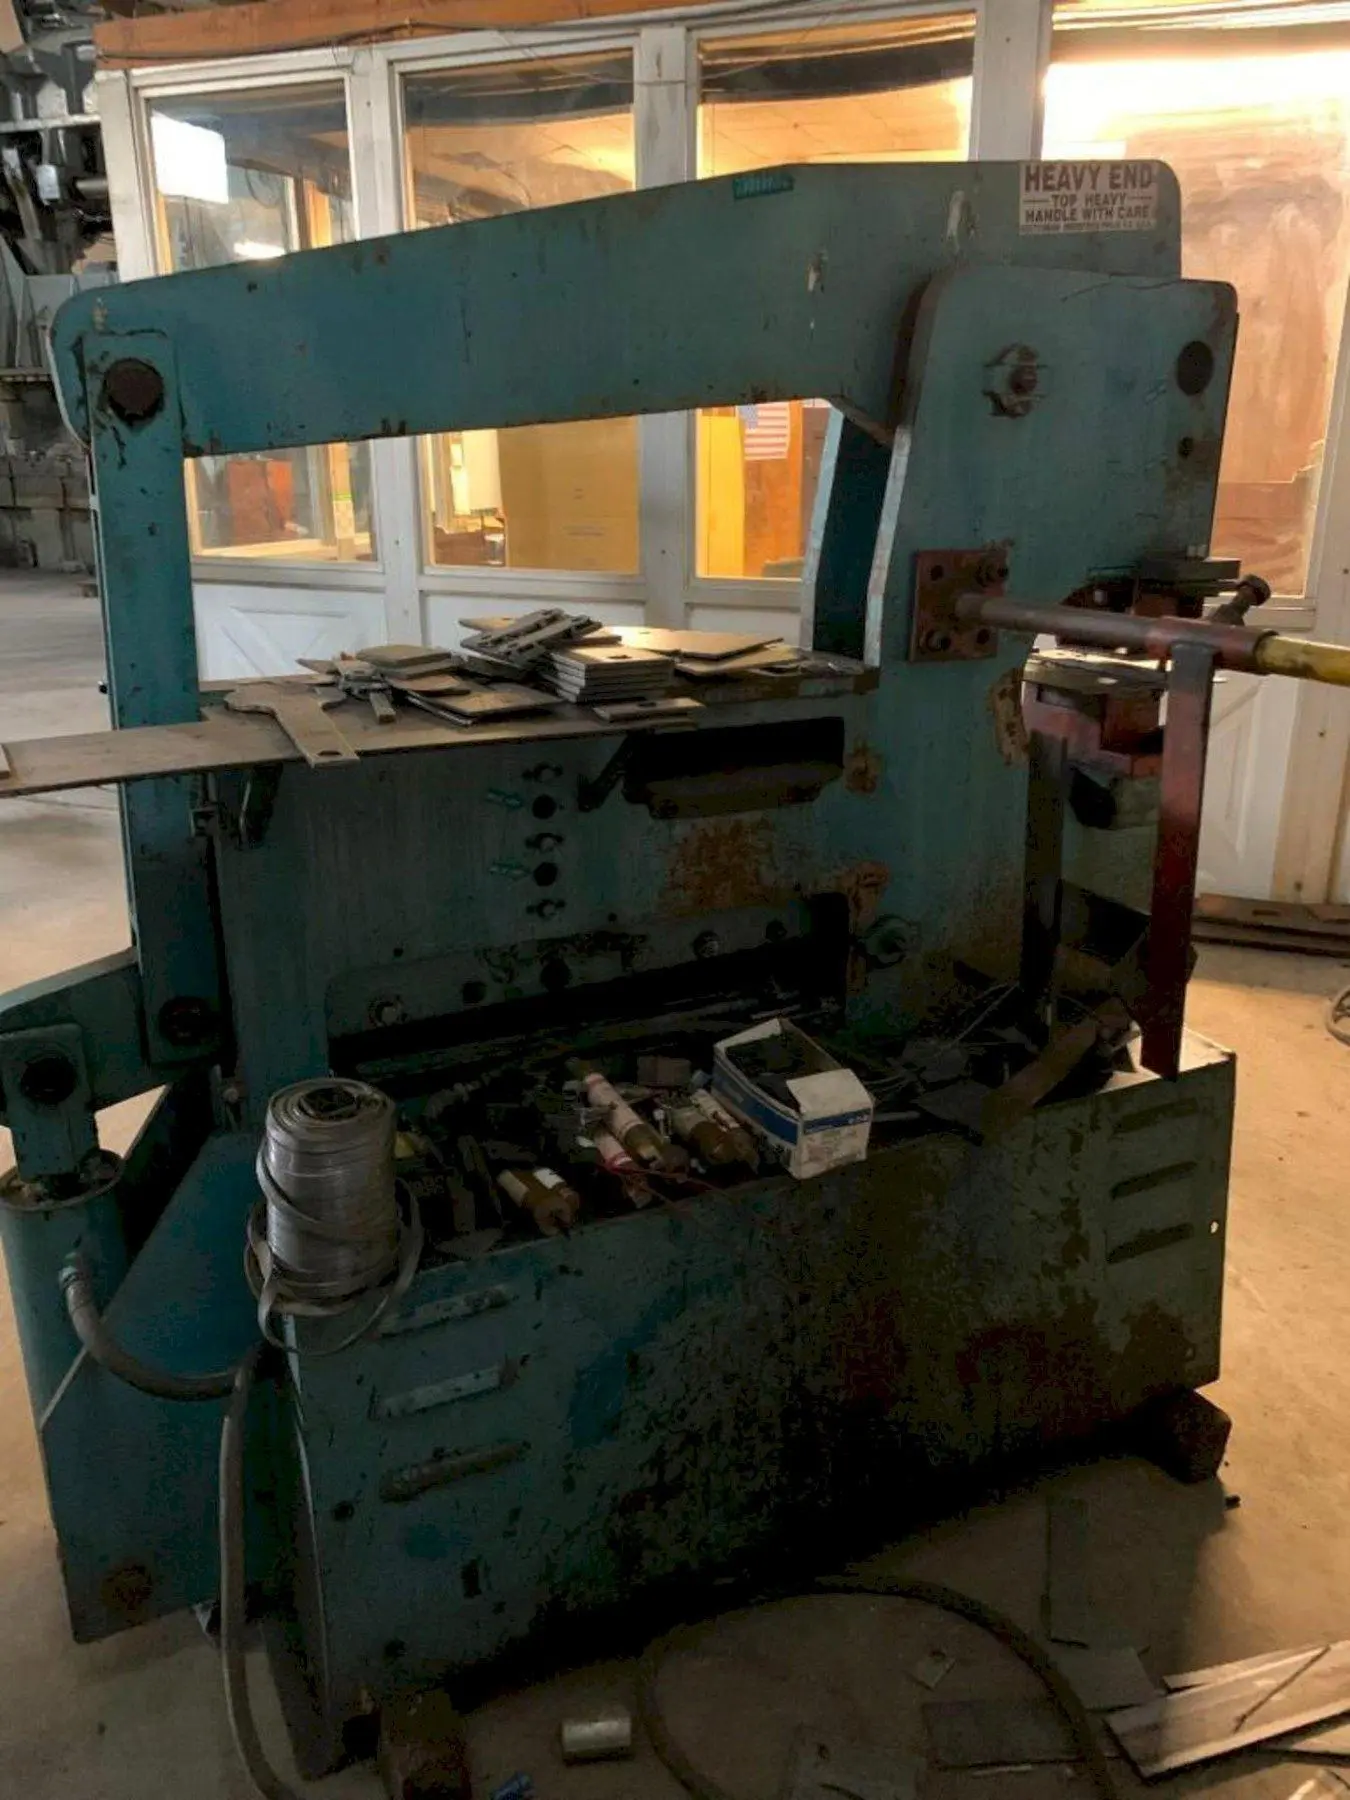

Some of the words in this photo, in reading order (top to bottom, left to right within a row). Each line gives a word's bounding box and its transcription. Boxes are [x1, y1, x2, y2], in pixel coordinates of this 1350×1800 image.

[1025, 164, 1100, 191] HEAVY
[1109, 163, 1153, 189] END
[1051, 194, 1077, 207] TOP
[1085, 193, 1126, 206] HEAVY
[1026, 208, 1078, 222] HANDLE
[1082, 207, 1114, 220] WITH
[1118, 205, 1149, 218] CARE
